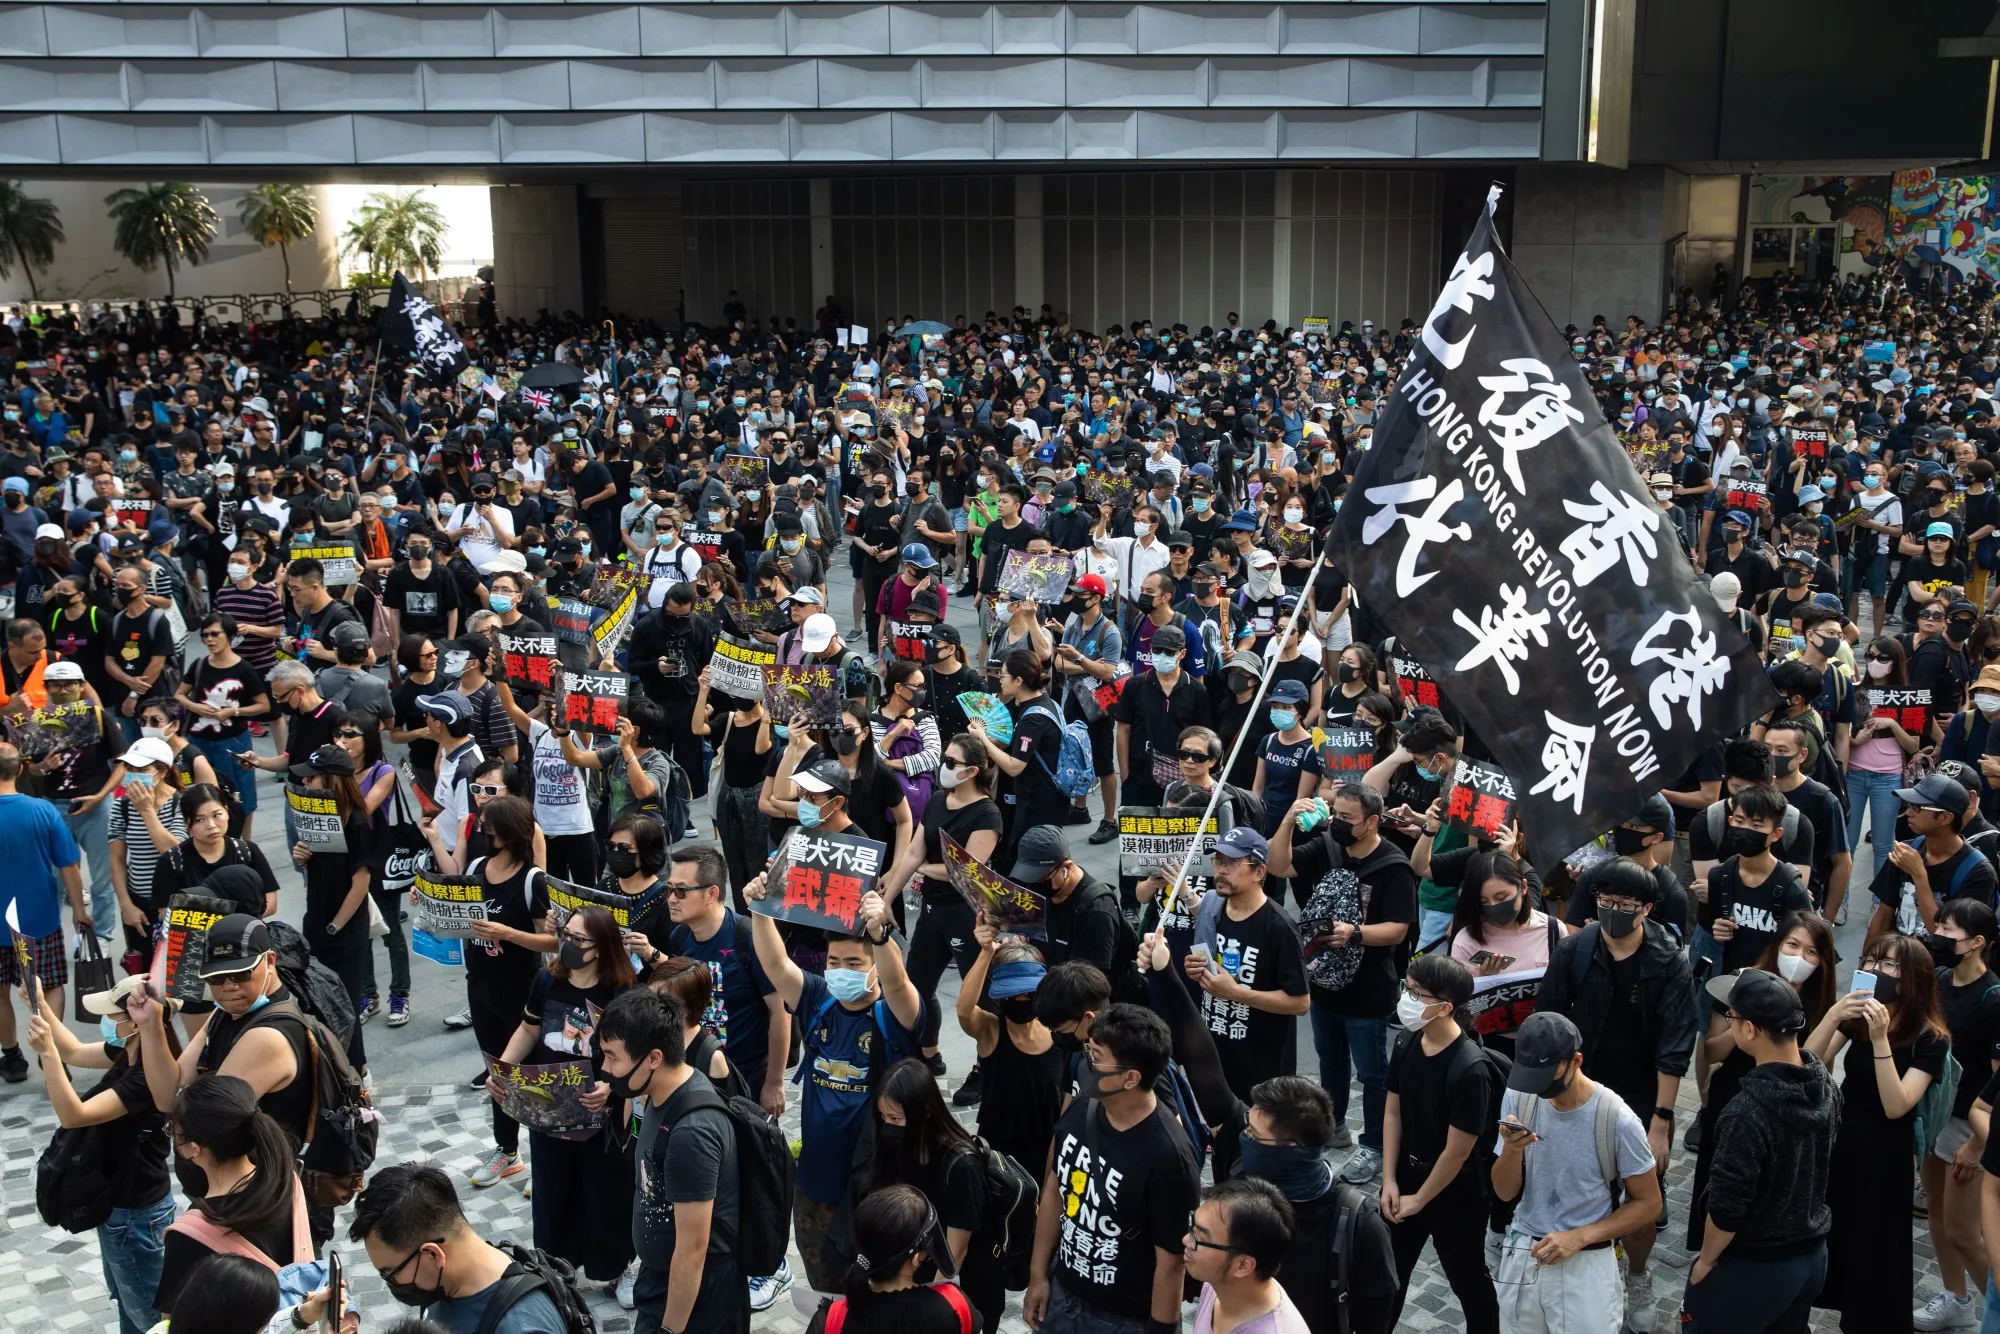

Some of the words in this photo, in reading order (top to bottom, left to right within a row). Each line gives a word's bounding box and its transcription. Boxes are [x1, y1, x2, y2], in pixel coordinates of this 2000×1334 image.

[1088, 471, 1133, 489] 正義必勝
[1727, 478, 1767, 494] 警犬不是
[464, 535, 497, 546] adidas
[1010, 555, 1070, 576] 正義必勝
[1401, 368, 1474, 455] HONG
[1603, 703, 1660, 783] NOW
[498, 633, 557, 655] 警犬不是
[504, 653, 551, 688] 武器
[767, 666, 836, 689] 正義必勝
[564, 672, 628, 697] 警犬不是
[1867, 688, 1933, 706] 警犬不是
[13, 699, 93, 729] 正義必勝
[564, 694, 619, 733] 武器
[1266, 752, 1298, 768] ROOTS
[1120, 817, 1218, 835] 譴責警察濫權
[786, 833, 879, 877] 警犬不是
[946, 843, 1042, 913] 正義必勝
[782, 866, 865, 930] 武器
[492, 1063, 590, 1087] 正義必勝
[812, 1073, 869, 1093] CHEVROLET
